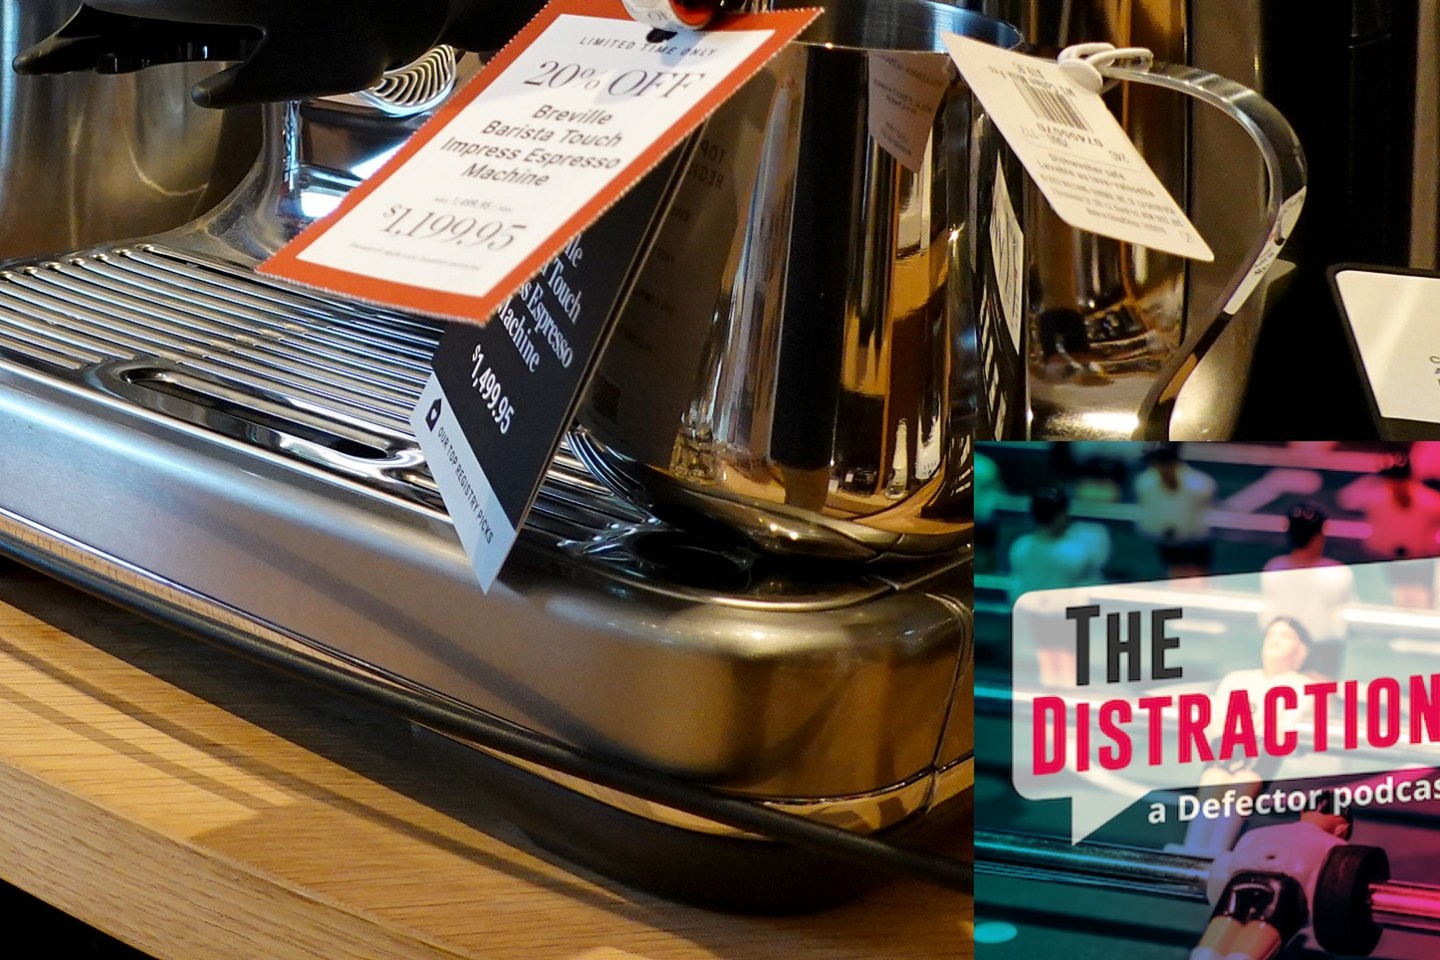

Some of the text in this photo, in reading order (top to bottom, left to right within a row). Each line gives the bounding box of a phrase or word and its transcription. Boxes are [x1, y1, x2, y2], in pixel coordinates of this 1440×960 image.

[578, 36, 718, 57] LIMITED TIME ONLY
[523, 59, 705, 98] 20% OFF
[532, 104, 613, 126] Breville
[482, 120, 622, 148] Barista Touch
[440, 136, 621, 169] Impress Espresso
[461, 163, 551, 186] Machine
[547, 257, 582, 324] Touch
[527, 282, 573, 368] Espresso
[471, 344, 515, 434] $1,499.95
[438, 427, 494, 544] OUR TOP REGISTRY PICKS
